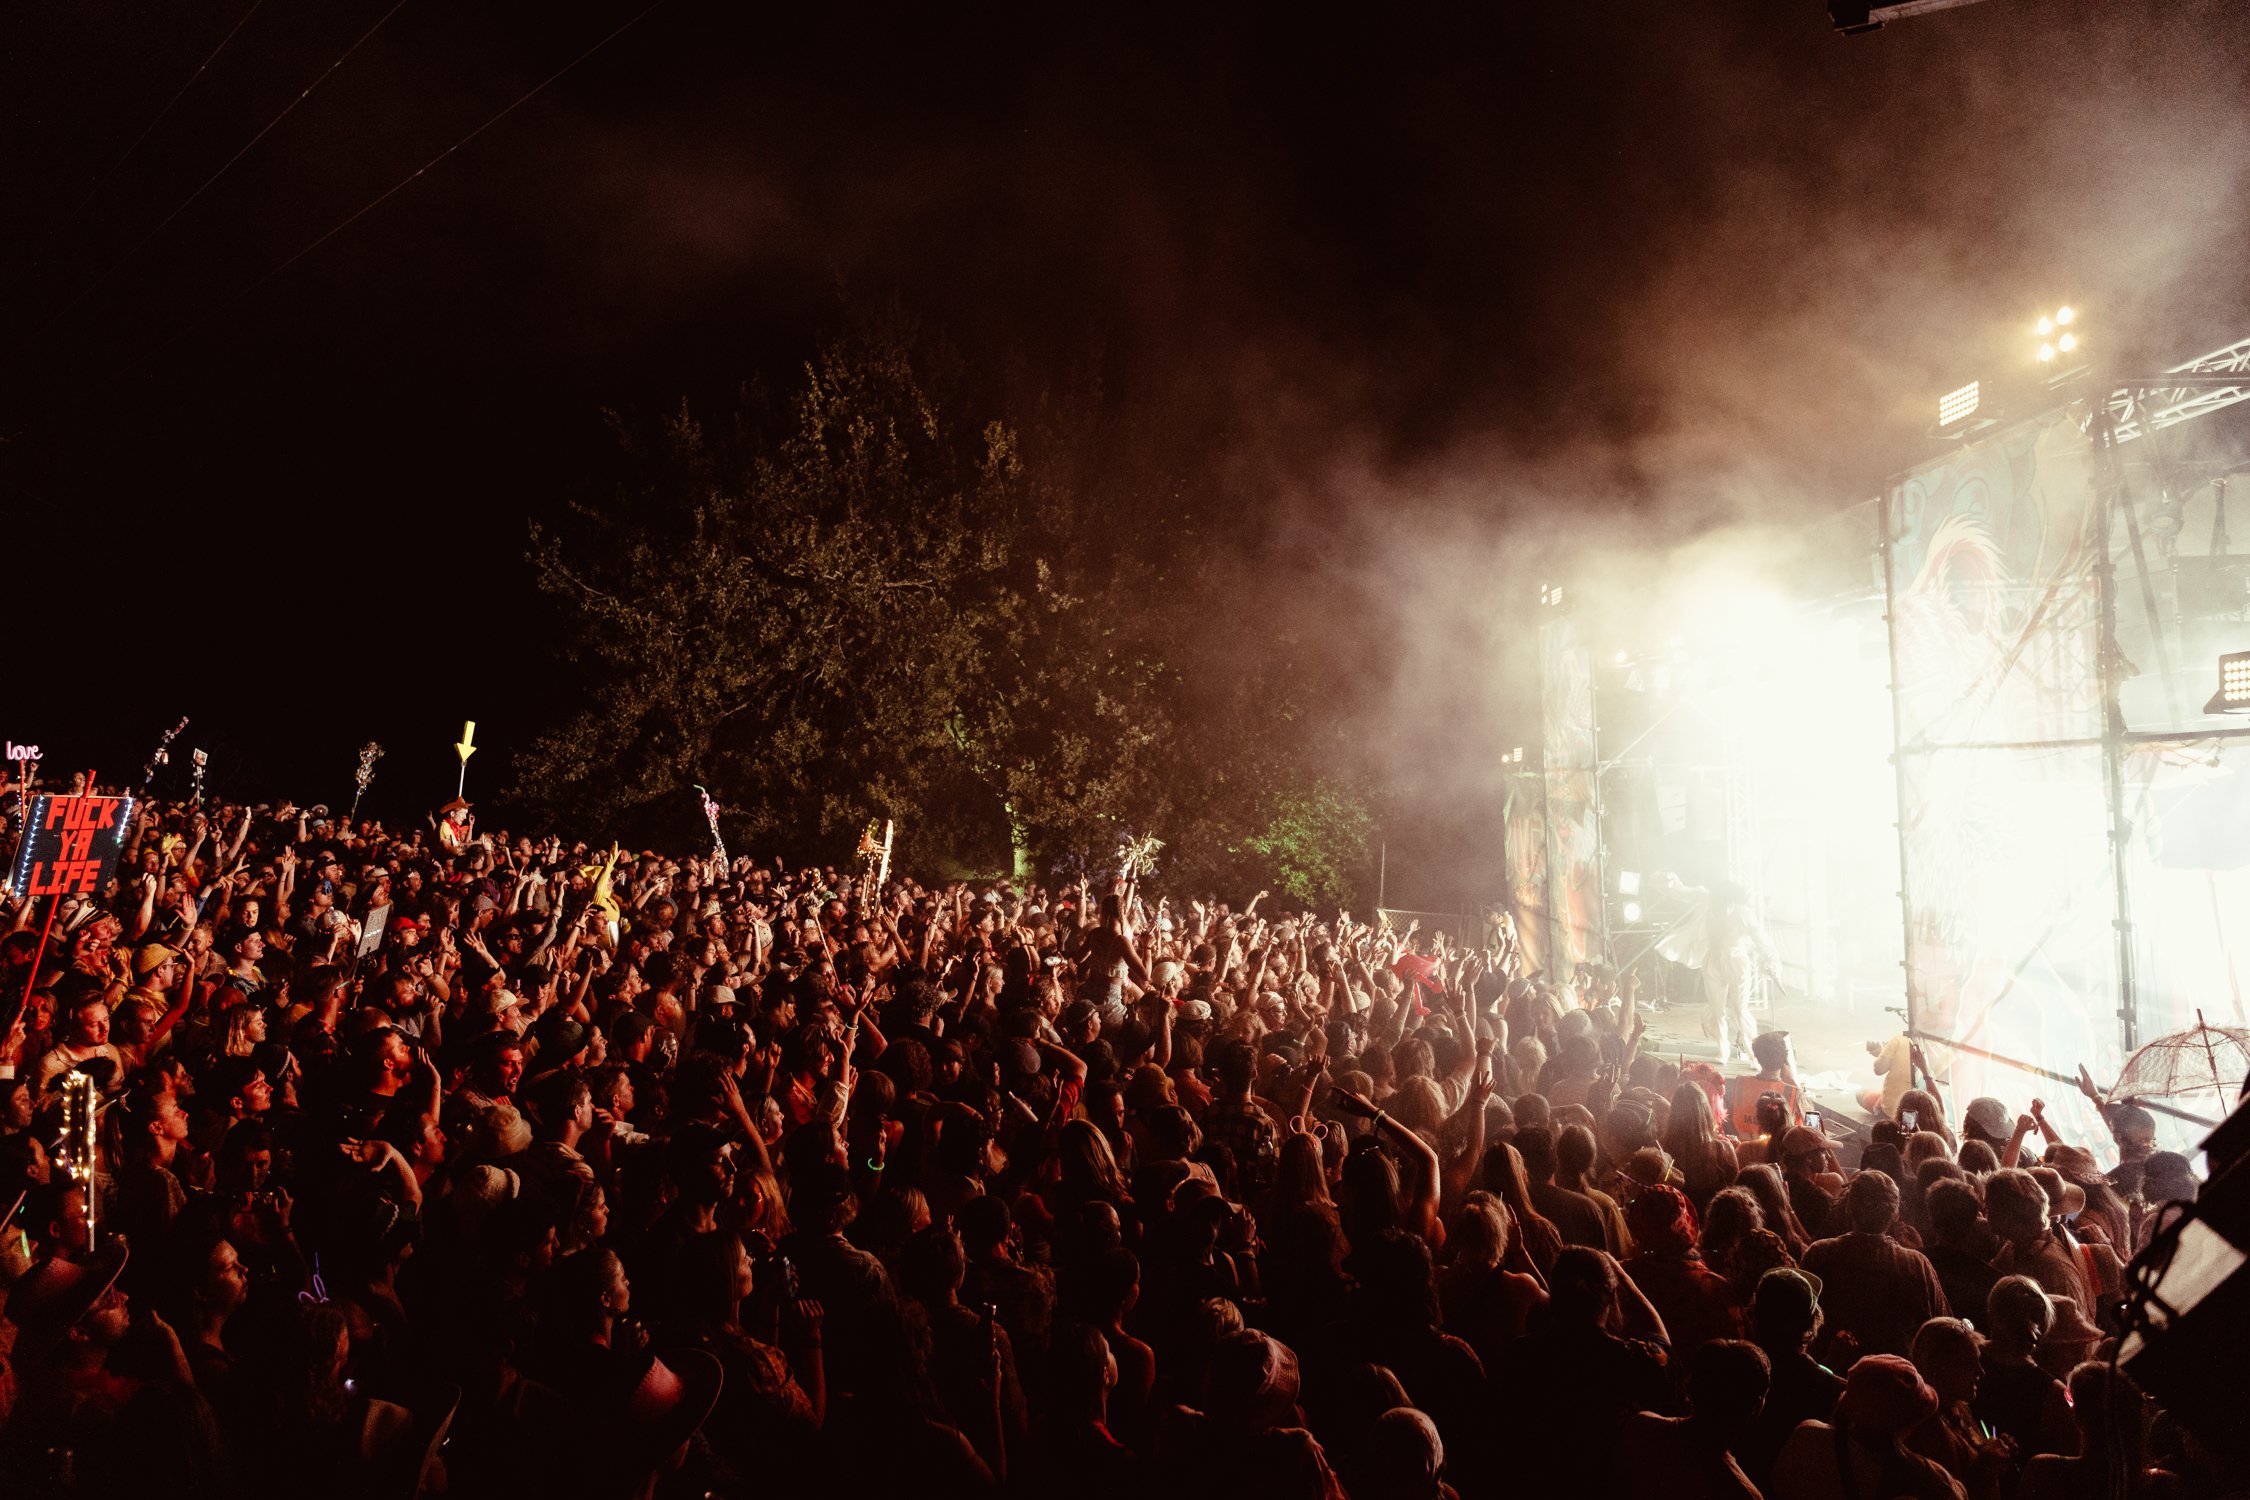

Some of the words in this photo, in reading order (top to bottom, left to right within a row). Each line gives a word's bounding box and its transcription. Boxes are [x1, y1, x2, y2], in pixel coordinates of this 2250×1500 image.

[6, 741, 43, 760] love
[45, 797, 119, 830] FUCK
[58, 829, 95, 862] YA
[28, 860, 101, 895] LIFE
